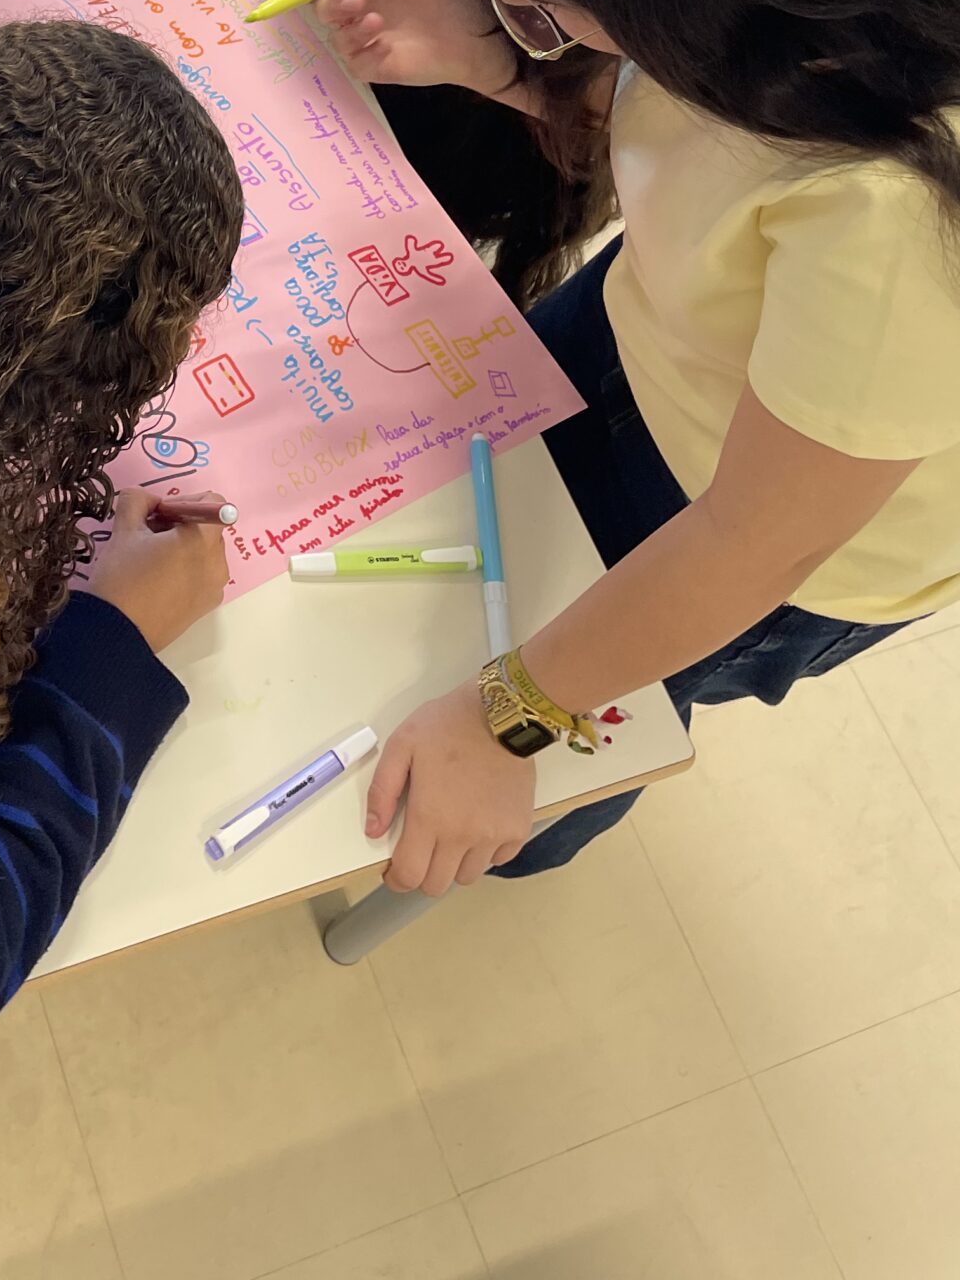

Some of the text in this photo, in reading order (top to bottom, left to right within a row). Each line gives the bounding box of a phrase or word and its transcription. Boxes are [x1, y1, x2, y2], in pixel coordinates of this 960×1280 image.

[169, 20, 204, 58] com
[216, 21, 243, 46] Ao
[232, 122, 314, 211] Assunto
[284, 277, 334, 328] pouca
[281, 354, 334, 423] muita
[252, 537, 267, 555] E
[265, 518, 312, 555] para
